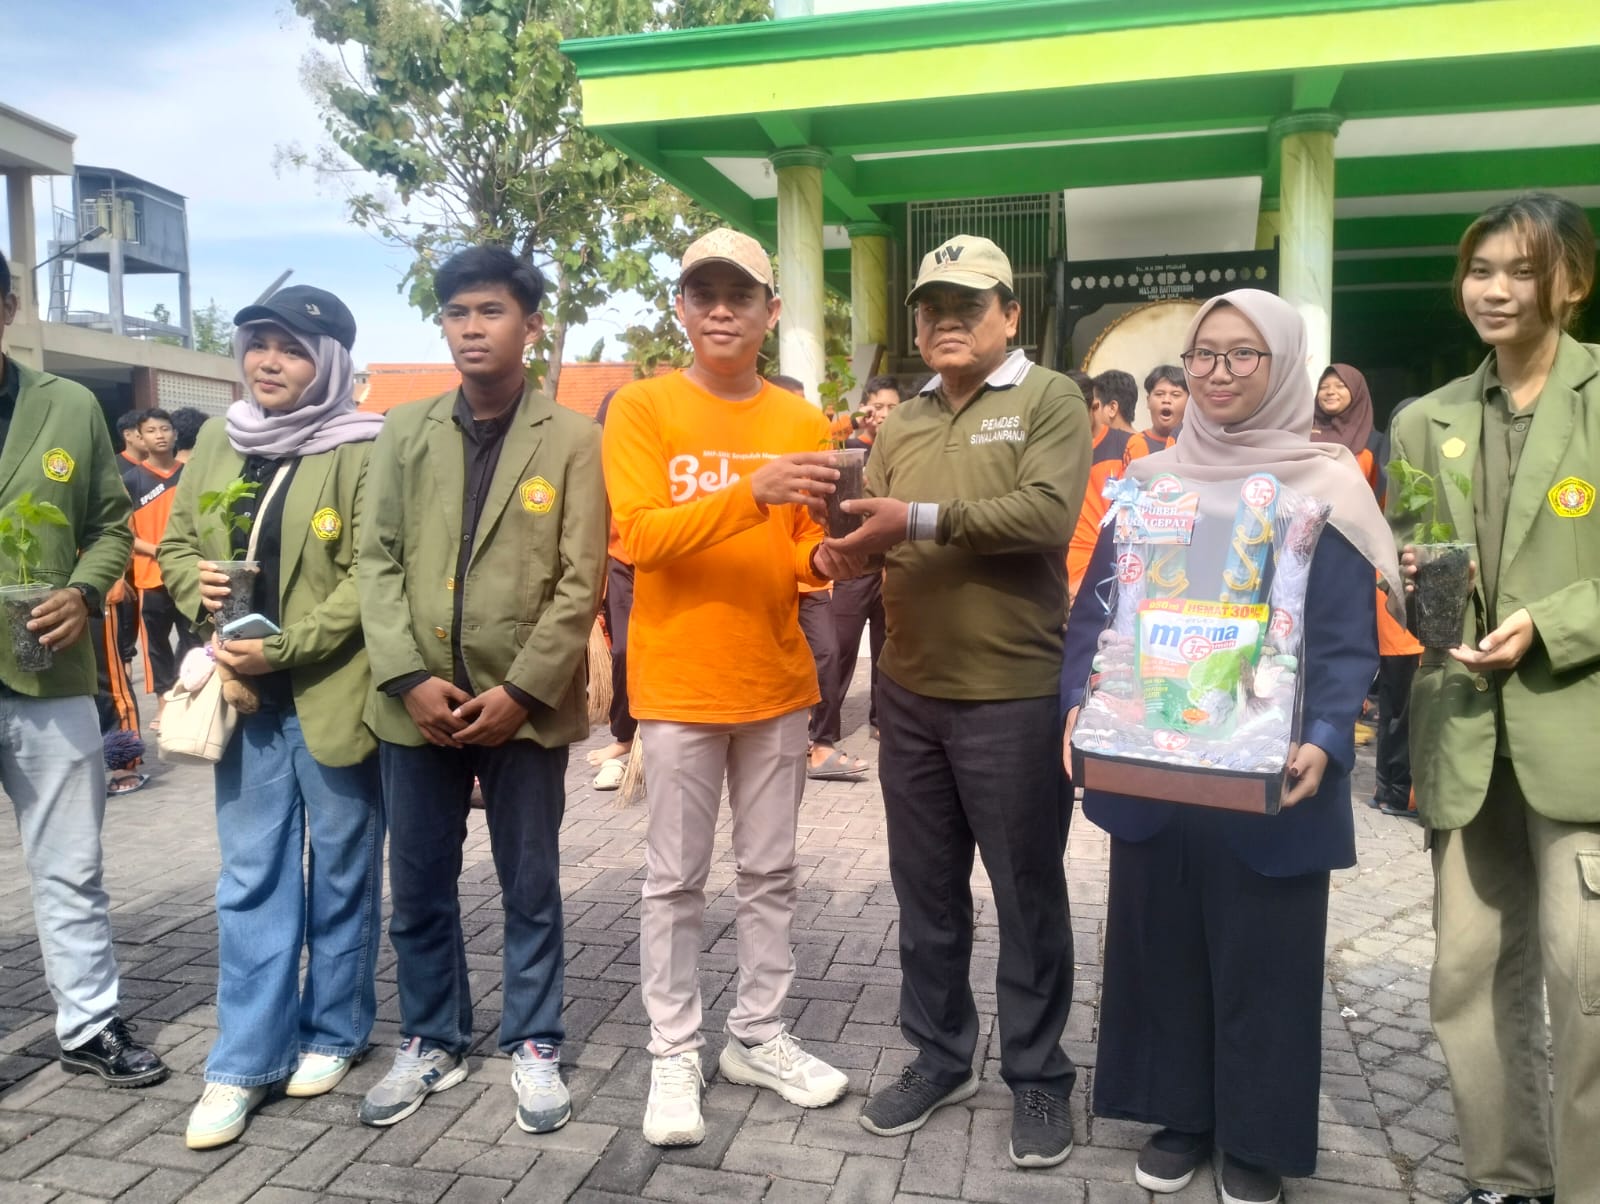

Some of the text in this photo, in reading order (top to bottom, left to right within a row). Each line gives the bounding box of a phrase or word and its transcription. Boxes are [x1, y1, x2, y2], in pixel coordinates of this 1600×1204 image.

[980, 415, 1020, 431] PEMDES
[140, 483, 165, 506] SPUBER
[1187, 604, 1229, 618] HEMAT
